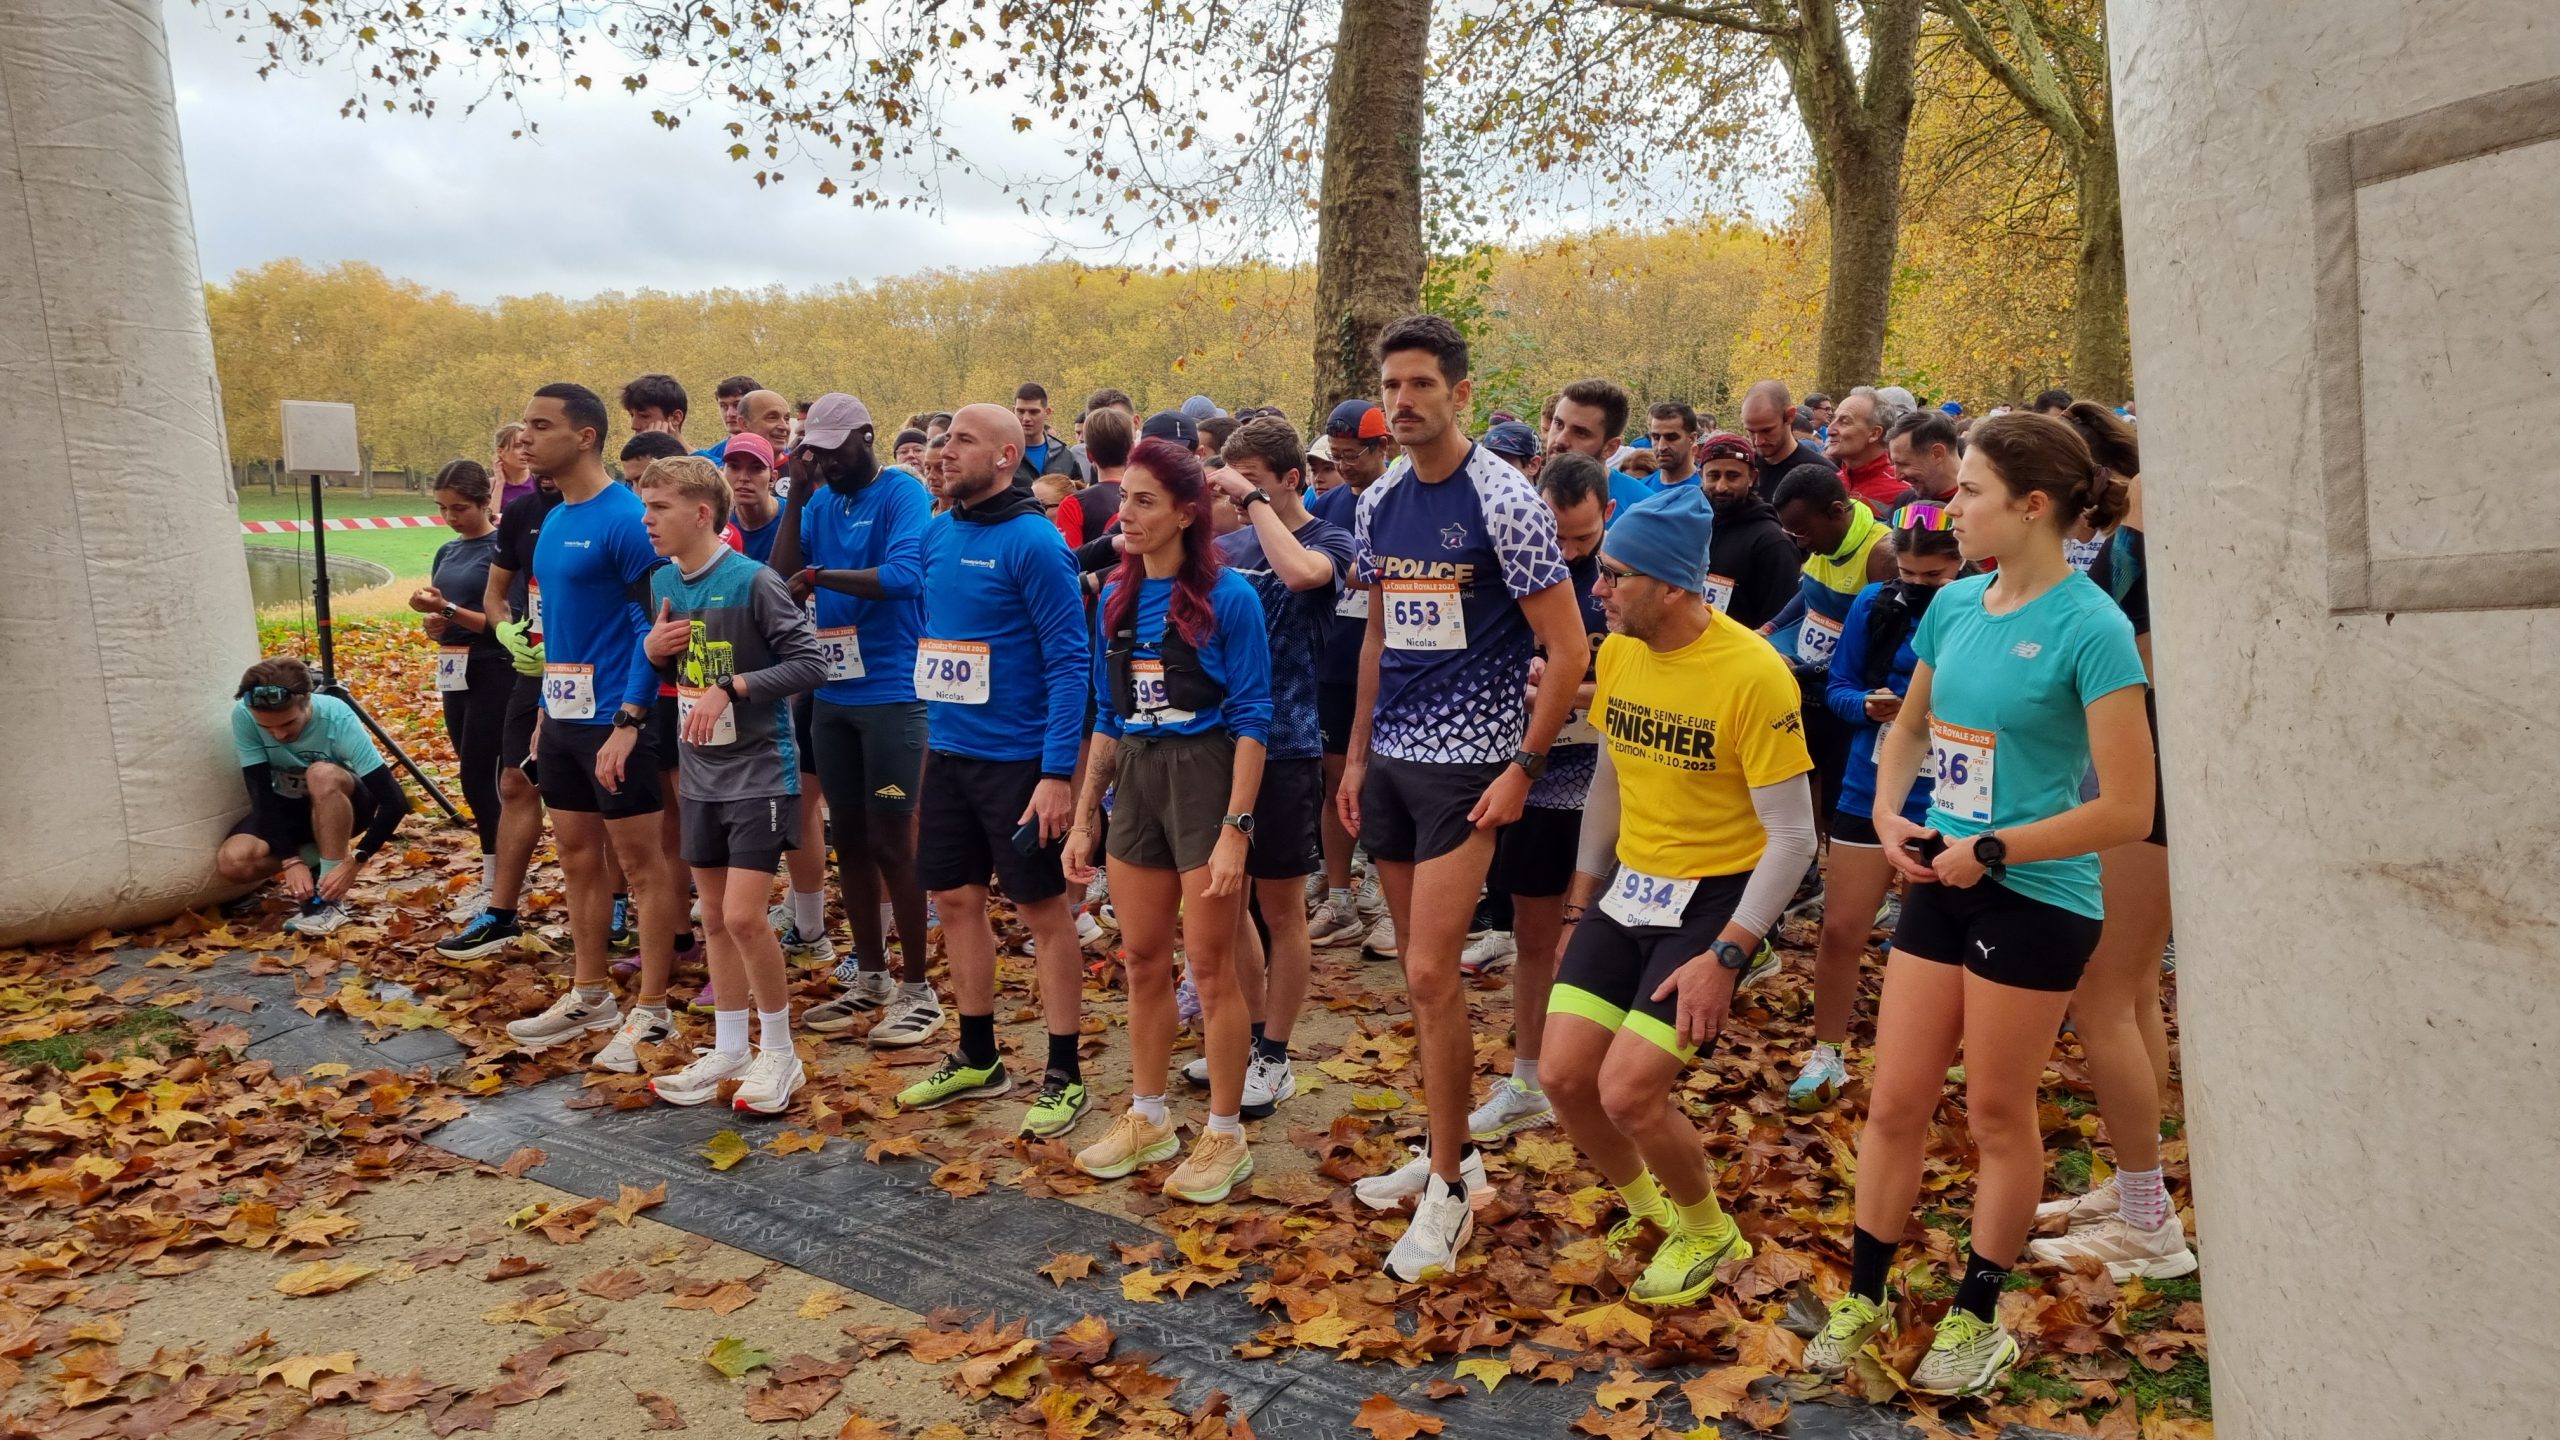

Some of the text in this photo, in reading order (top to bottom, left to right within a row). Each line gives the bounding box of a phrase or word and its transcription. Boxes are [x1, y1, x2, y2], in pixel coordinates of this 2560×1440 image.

[1384, 557, 1474, 583] POLICE
[1395, 601, 1440, 626] 653
[1406, 638, 1437, 647] Nicolas
[1805, 627, 1839, 655] 627
[820, 643, 844, 662] 25
[927, 658, 971, 682] 780
[547, 680, 576, 699] 982
[936, 691, 964, 700] Nicolas
[1608, 696, 1717, 731] MARATHON SEINE-EURE
[1606, 706, 1716, 759] FINISHER
[1942, 726, 1969, 740] ROYALE
[1970, 733, 1990, 744] 2025
[1653, 751, 1717, 771] 19.10.2025
[1622, 873, 1674, 909] 934
[1627, 913, 1651, 926] David
